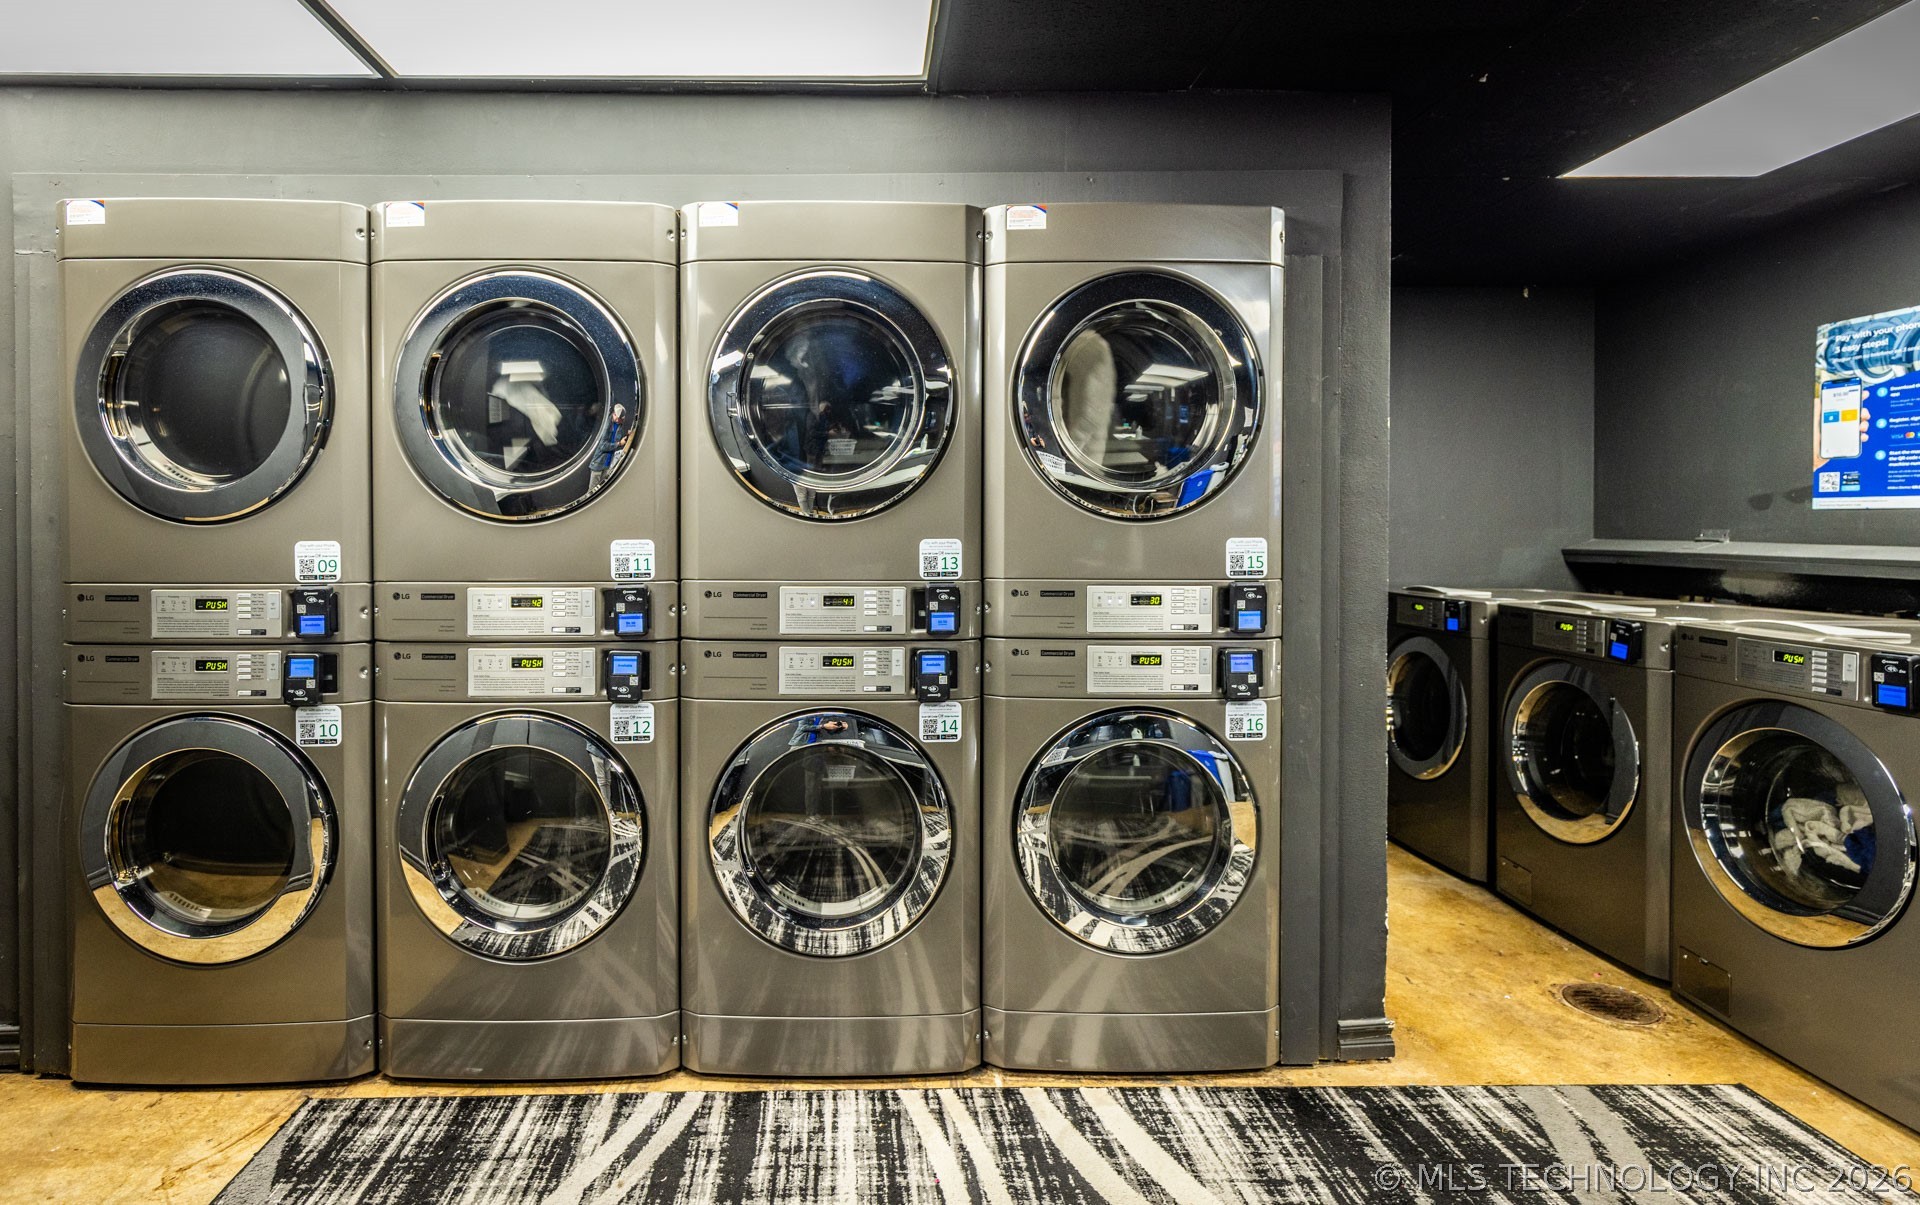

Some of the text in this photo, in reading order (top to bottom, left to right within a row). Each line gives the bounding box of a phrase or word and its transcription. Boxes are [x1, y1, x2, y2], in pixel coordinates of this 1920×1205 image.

[1835, 334, 1851, 343] Pay
[1852, 330, 1872, 340] with
[1872, 327, 1894, 338] your
[1841, 343, 1861, 352] easy
[1862, 337, 1889, 349] steps!
[318, 560, 337, 573] 09
[634, 558, 651, 571] 11
[941, 556, 959, 570] 13
[1247, 555, 1264, 569] 15
[205, 601, 227, 609] PUSH
[532, 599, 542, 607] 42
[843, 598, 853, 606] 41
[1150, 596, 1160, 605] 30
[521, 659, 542, 668] PUSH
[831, 658, 853, 666] PUSH
[1139, 657, 1160, 665] PUSH
[1783, 653, 1804, 664] PUSH
[205, 662, 227, 670] PUSH
[320, 723, 339, 737] 10
[633, 720, 651, 734] 12
[941, 719, 959, 733] 14
[1247, 718, 1264, 731] 16
